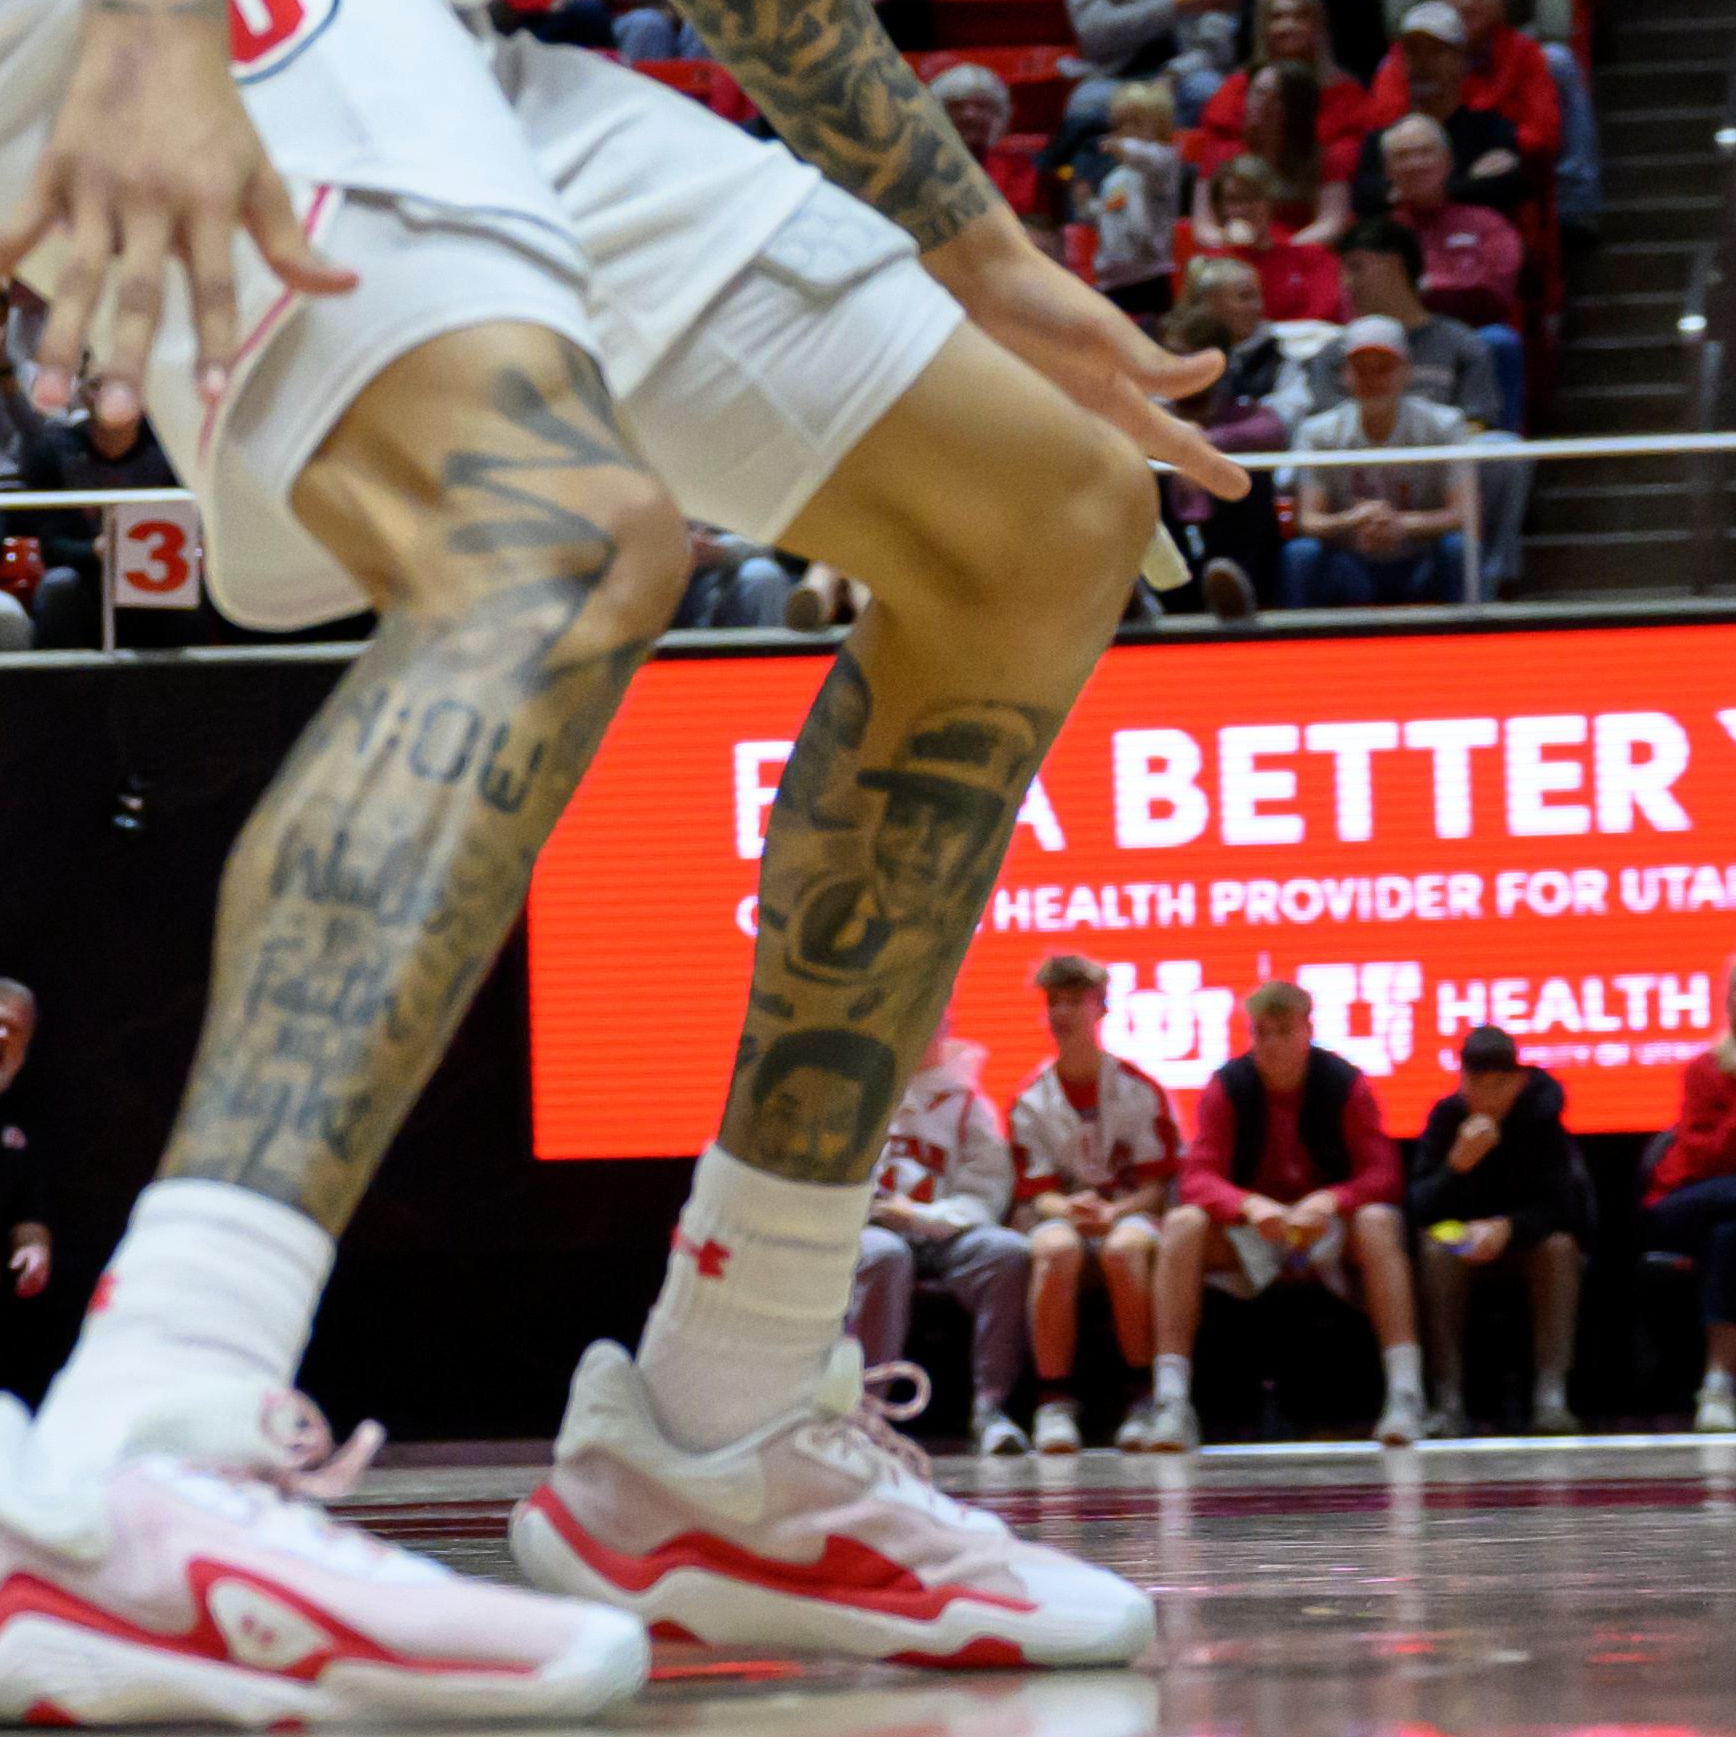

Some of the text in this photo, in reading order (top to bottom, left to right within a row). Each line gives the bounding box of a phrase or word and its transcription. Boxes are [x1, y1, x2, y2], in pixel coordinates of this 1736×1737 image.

[126, 521, 189, 593] 3
[1113, 711, 1692, 850] BETTER
[993, 881, 1191, 933] HEALTH
[1211, 871, 1485, 926] PROVIDER
[1498, 867, 1608, 919] FOR
[1436, 972, 1711, 1037] HEALTH
